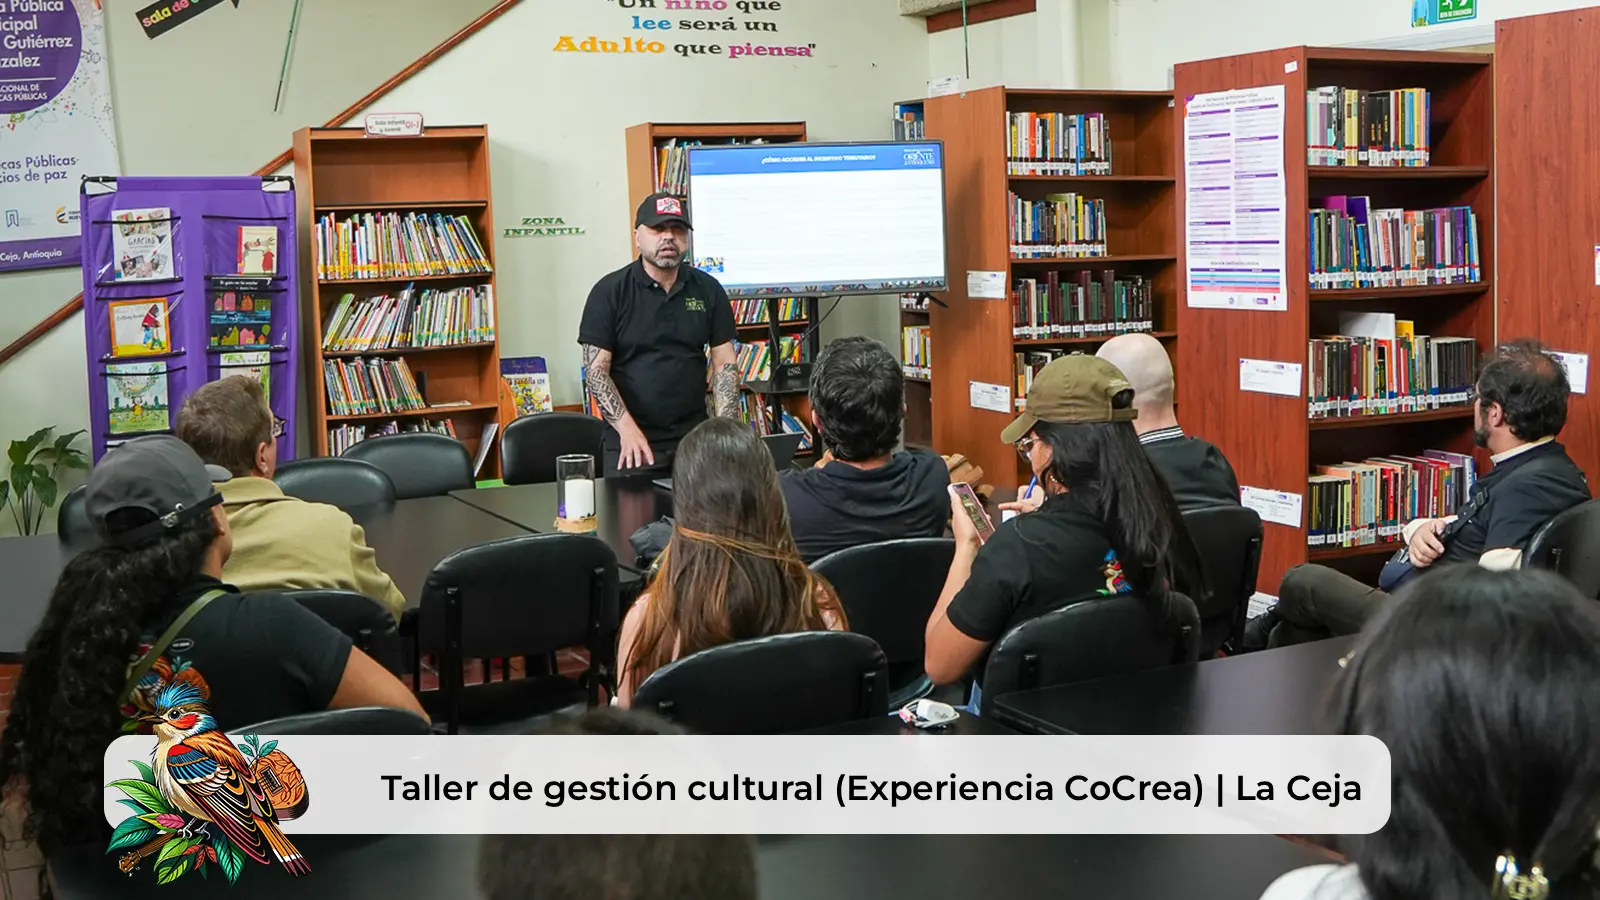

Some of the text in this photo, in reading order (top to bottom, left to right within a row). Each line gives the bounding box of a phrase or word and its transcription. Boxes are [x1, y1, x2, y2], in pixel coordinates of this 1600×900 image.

[11, 0, 64, 12] Pública
[736, 0, 782, 13] que
[142, 7, 172, 27] sala
[632, 16, 778, 32] lee será un
[3, 34, 74, 49] Gutiérrez
[553, 36, 665, 53] Adulto
[673, 43, 722, 57] que
[0, 52, 41, 68] zalez
[0, 84, 29, 93] CIONAL
[14, 92, 47, 101] PÚBLICAS
[0, 161, 22, 170] cas
[24, 169, 40, 181] de
[44, 171, 67, 183] paz
[521, 217, 565, 225] ZONA
[504, 228, 585, 236] INFANTIL
[23, 249, 62, 259] Antioquia
